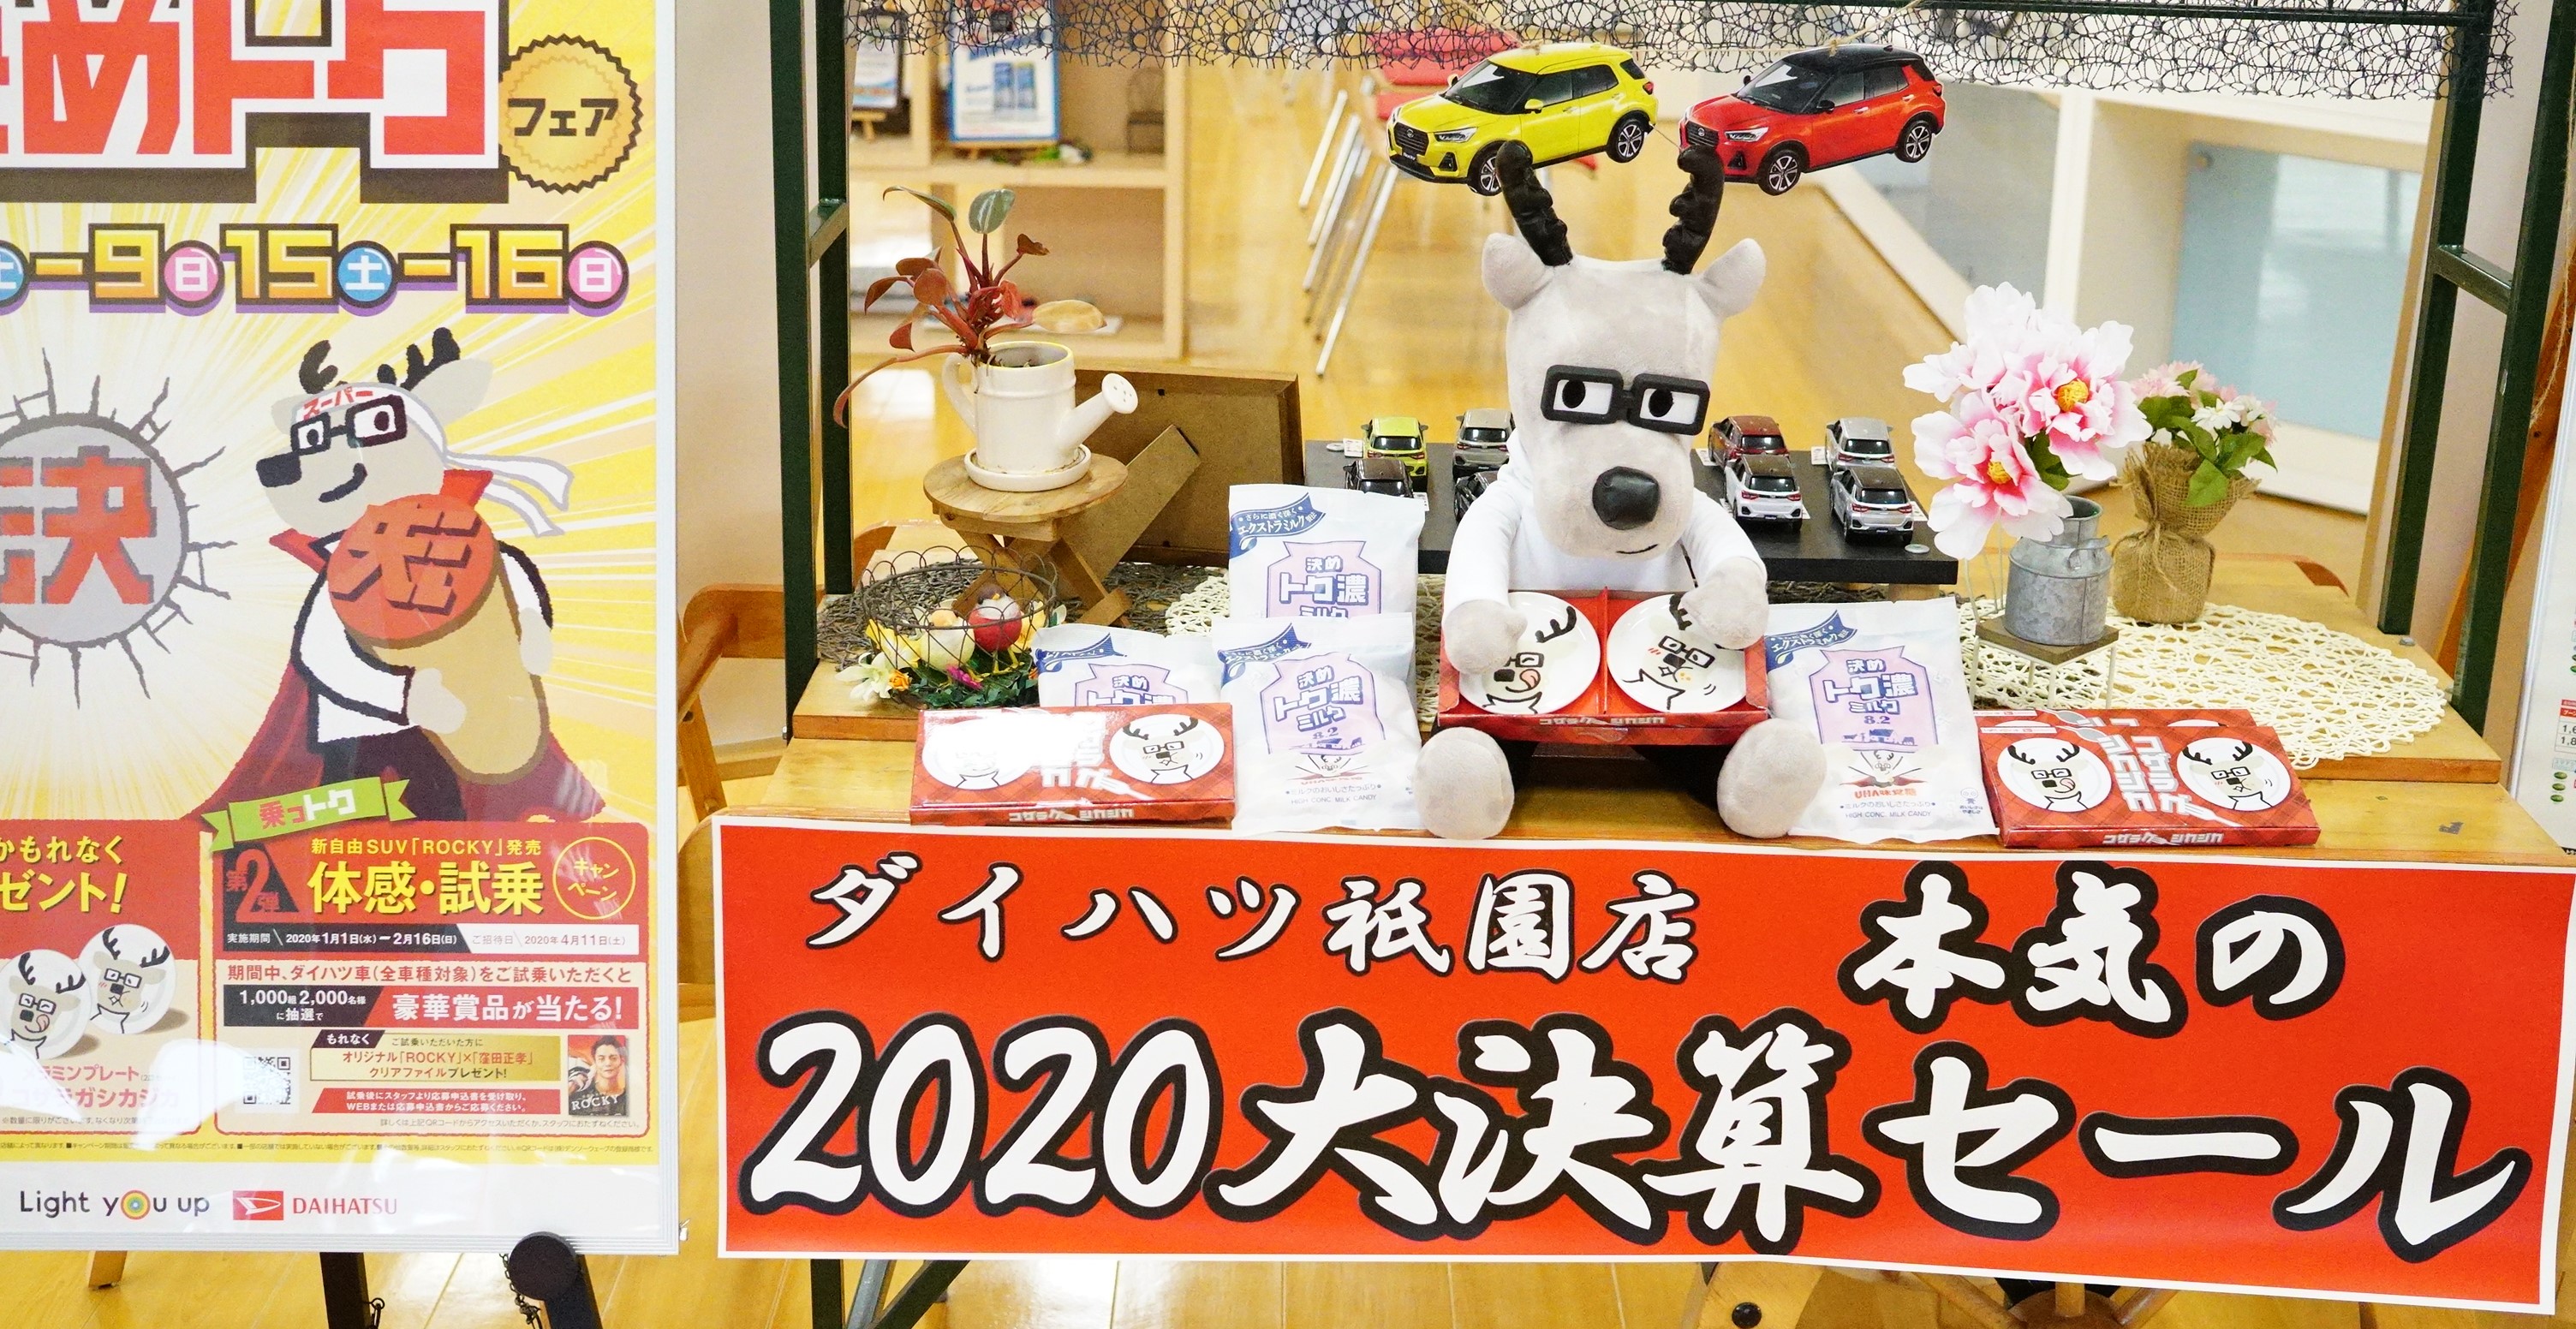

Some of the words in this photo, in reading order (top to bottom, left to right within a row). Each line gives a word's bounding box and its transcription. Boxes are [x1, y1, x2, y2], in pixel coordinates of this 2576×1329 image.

[507, 97, 618, 137] フェア
[304, 386, 373, 420] スーパー
[1305, 557, 1342, 572] 決め
[1279, 572, 1368, 605] トク濃
[1297, 665, 1335, 688] 決め
[1846, 659, 1886, 673] 決め
[1112, 675, 1150, 692] 決め
[1822, 671, 1919, 703] トク濃
[1273, 675, 1363, 722] トク濃
[1849, 700, 1901, 715] ミルク
[1297, 705, 1347, 731] ミルク
[1863, 715, 1891, 725] 8.2
[574, 857, 619, 879] キャン
[308, 859, 545, 915] 体感・試乗
[567, 882, 617, 902] ペーン
[227, 933, 271, 944] 実施期間
[807, 853, 1698, 983] ダイハツ祇園店
[1843, 862, 2342, 1036] 本気の
[277, 1008, 324, 1022] に抽選で
[326, 1033, 371, 1045] もれなく
[571, 1095, 619, 1111] ROCKY
[741, 1008, 2530, 1259] 2020大決算セール
[21, 1190, 89, 1219] Light
[177, 1195, 210, 1217] up
[293, 1197, 398, 1214] DAIHATSU
